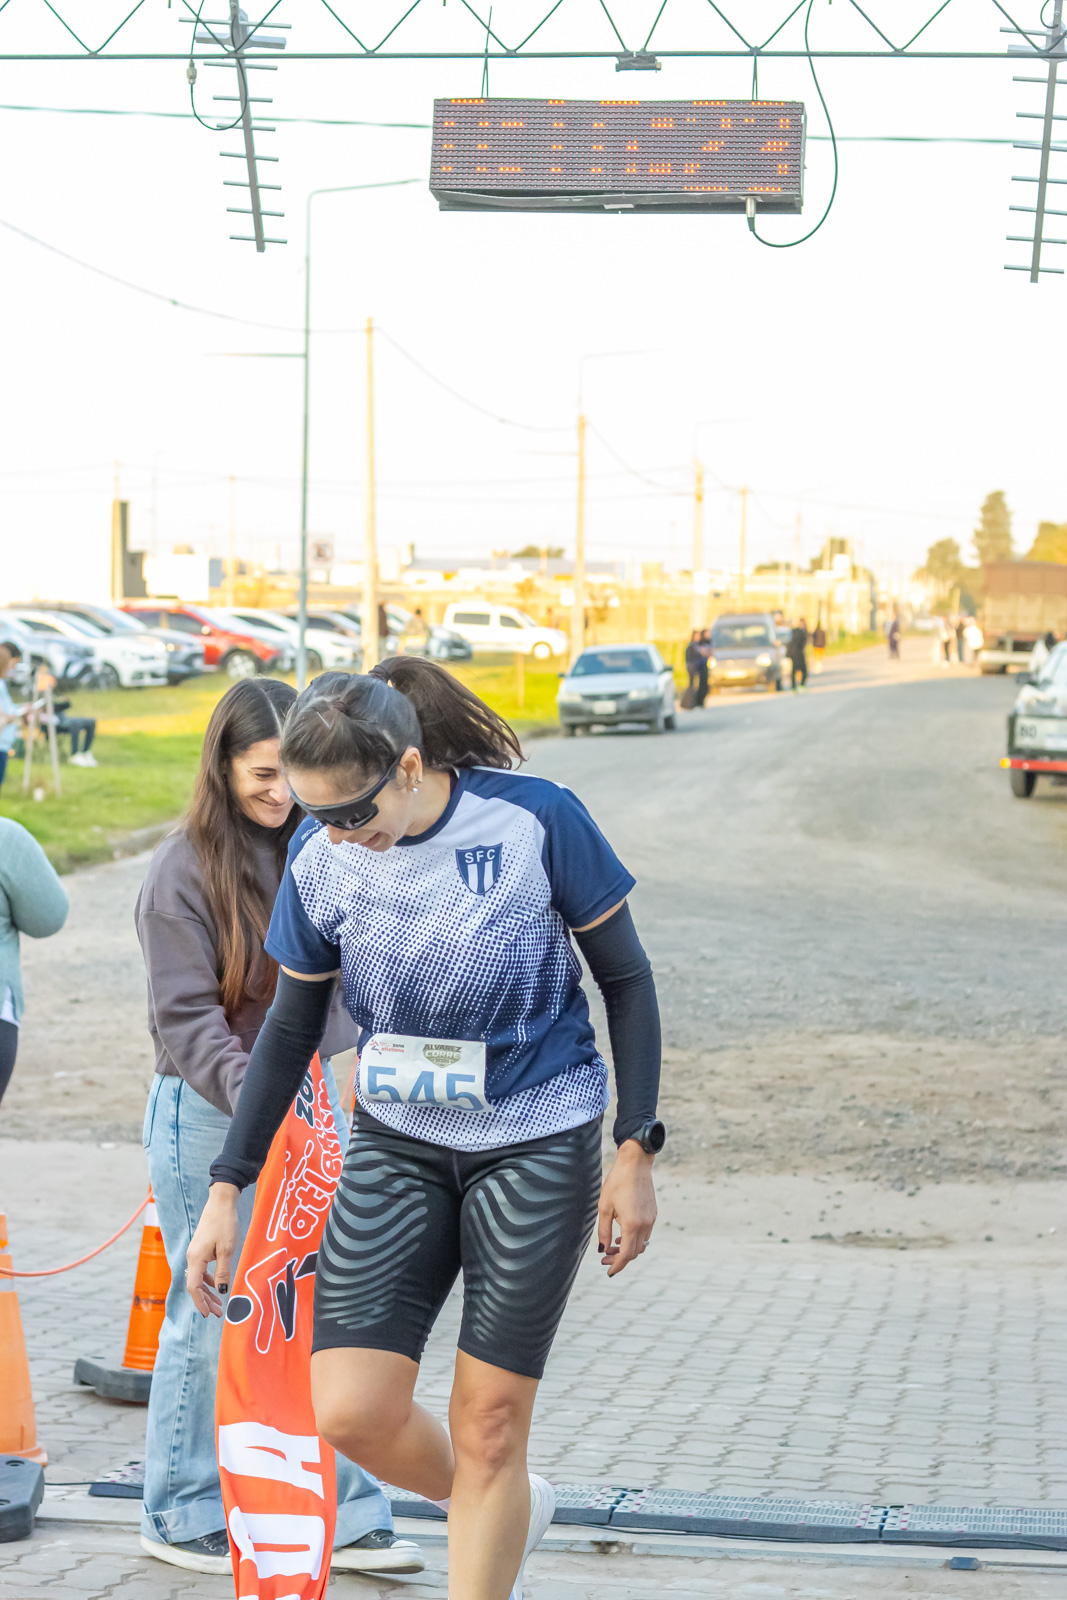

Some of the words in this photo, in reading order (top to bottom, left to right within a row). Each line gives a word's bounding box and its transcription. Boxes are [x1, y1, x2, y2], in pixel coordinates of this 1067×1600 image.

[464, 849, 496, 864] SFC
[423, 1044, 463, 1052] ALVAREZ
[425, 1050, 460, 1059] CORRE
[367, 1066, 485, 1112] 545
